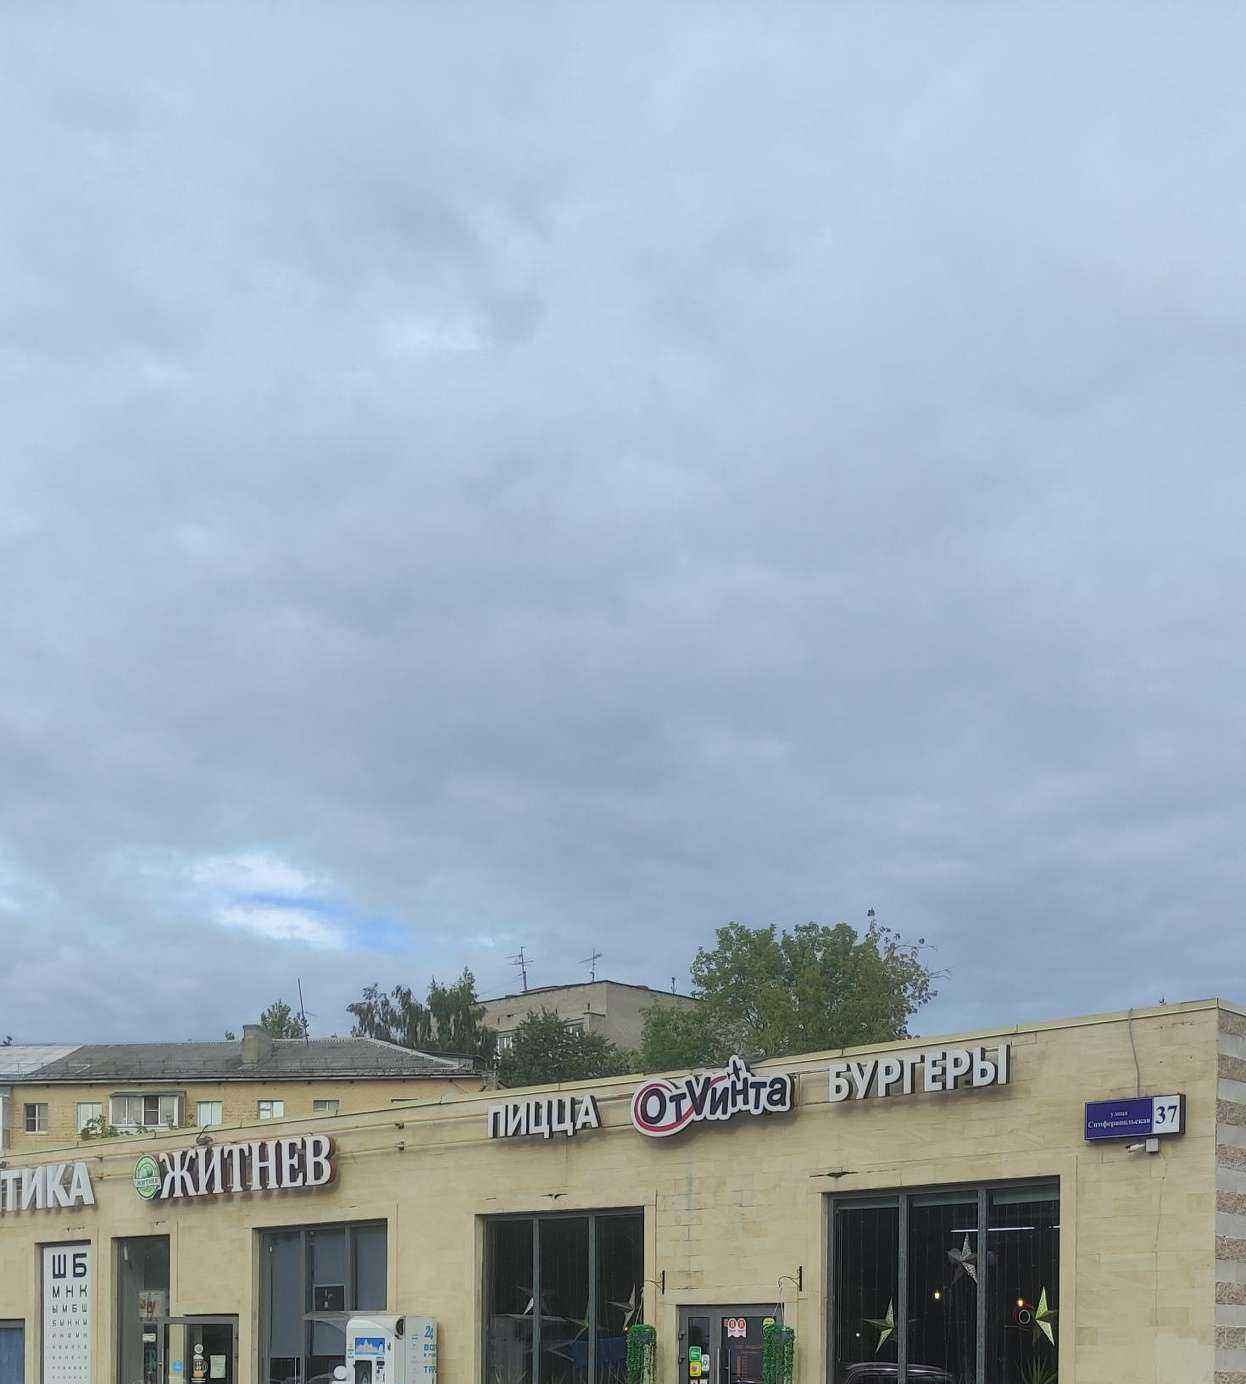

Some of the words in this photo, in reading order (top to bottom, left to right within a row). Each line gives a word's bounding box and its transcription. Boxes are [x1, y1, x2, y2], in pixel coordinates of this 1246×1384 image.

[829, 1042, 1010, 1103] БУРГЕРЫ
[487, 1095, 601, 1139] ПИЦЦА
[1155, 1105, 1178, 1124] 37
[0, 1162, 95, 1211] ТИКА
[159, 1135, 335, 1199] ЖИТНЕВ
